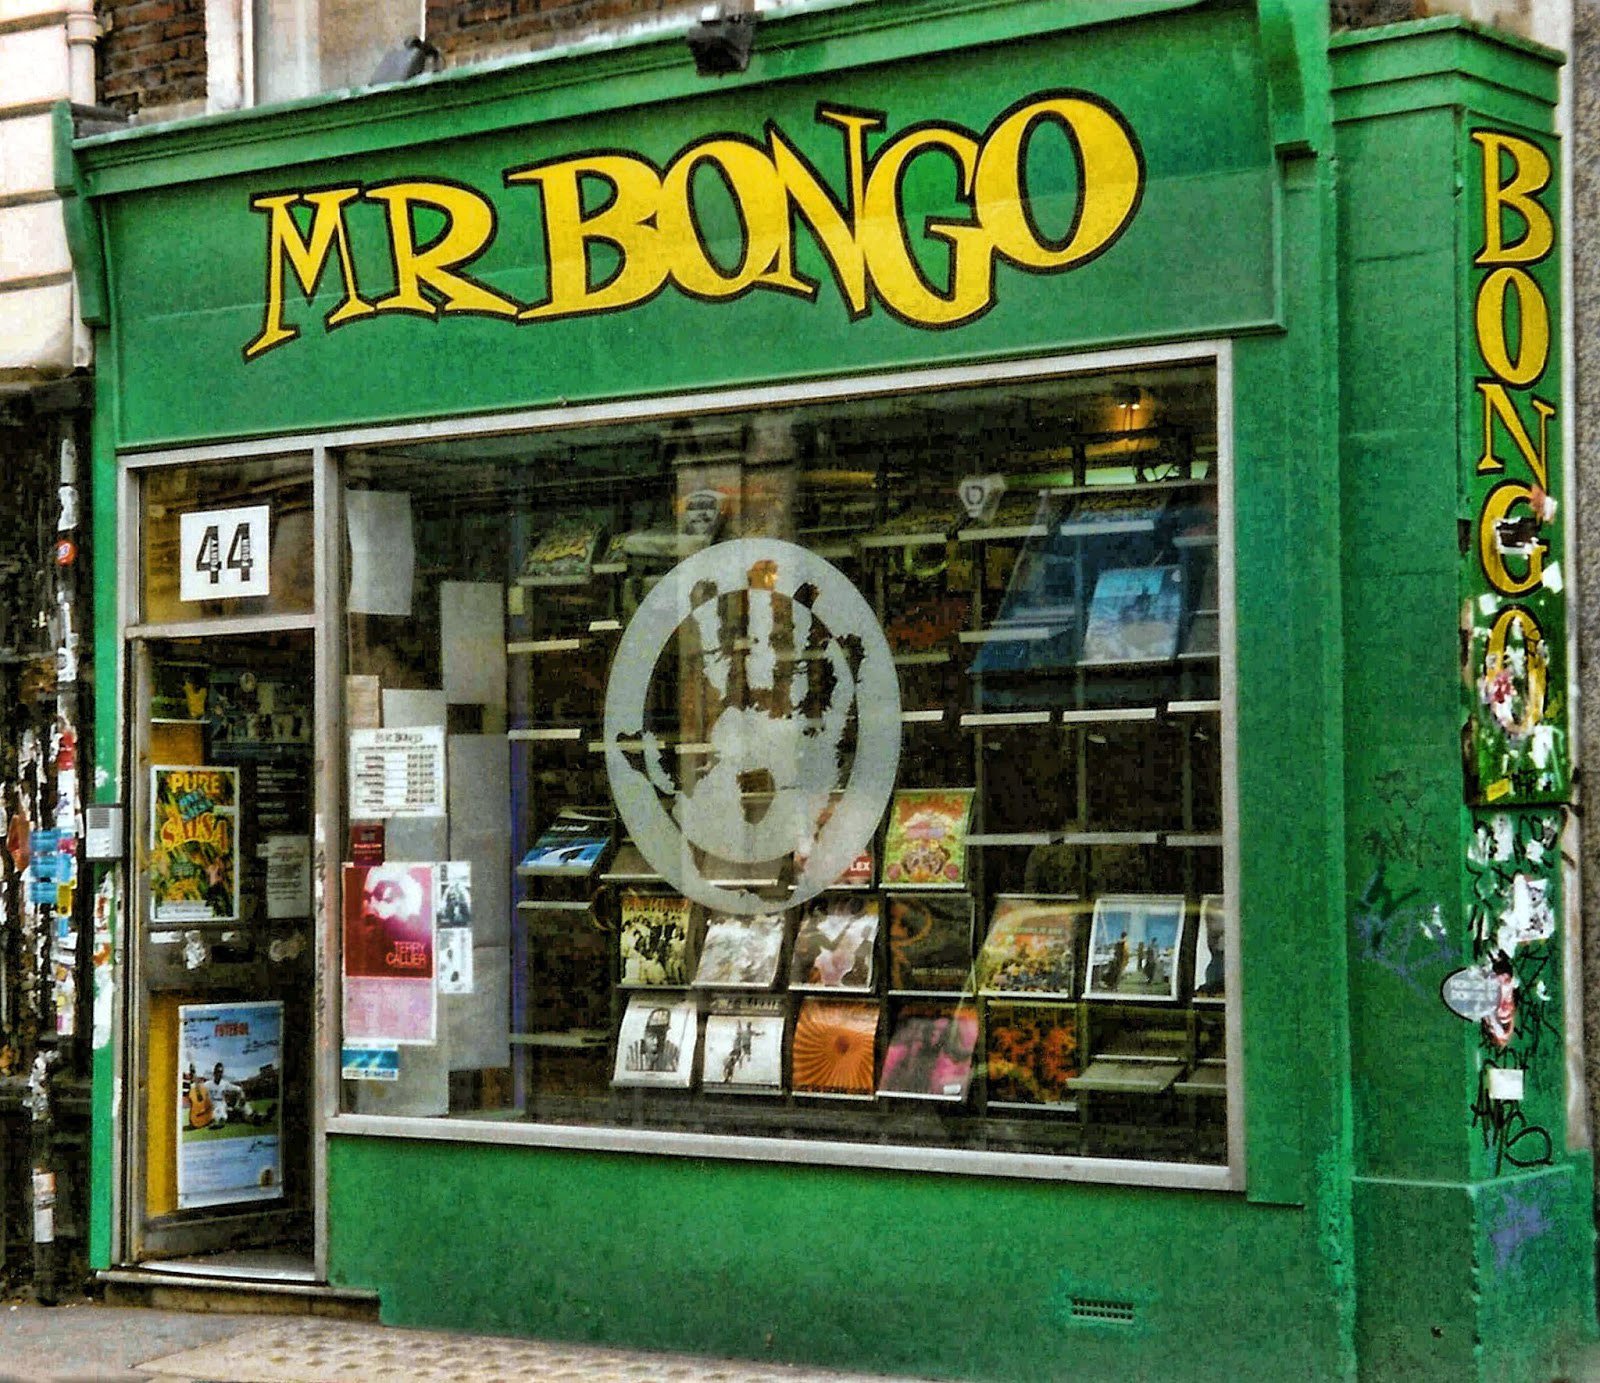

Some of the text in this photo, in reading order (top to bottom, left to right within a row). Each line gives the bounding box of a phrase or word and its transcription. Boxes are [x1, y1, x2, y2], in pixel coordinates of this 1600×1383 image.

[245, 89, 1145, 361] MR BONGO
[1471, 131, 1556, 736] BONGO
[196, 522, 253, 584] 44
[168, 772, 221, 797] PURE
[161, 812, 229, 854] SALSA
[393, 940, 426, 952] TERRY
